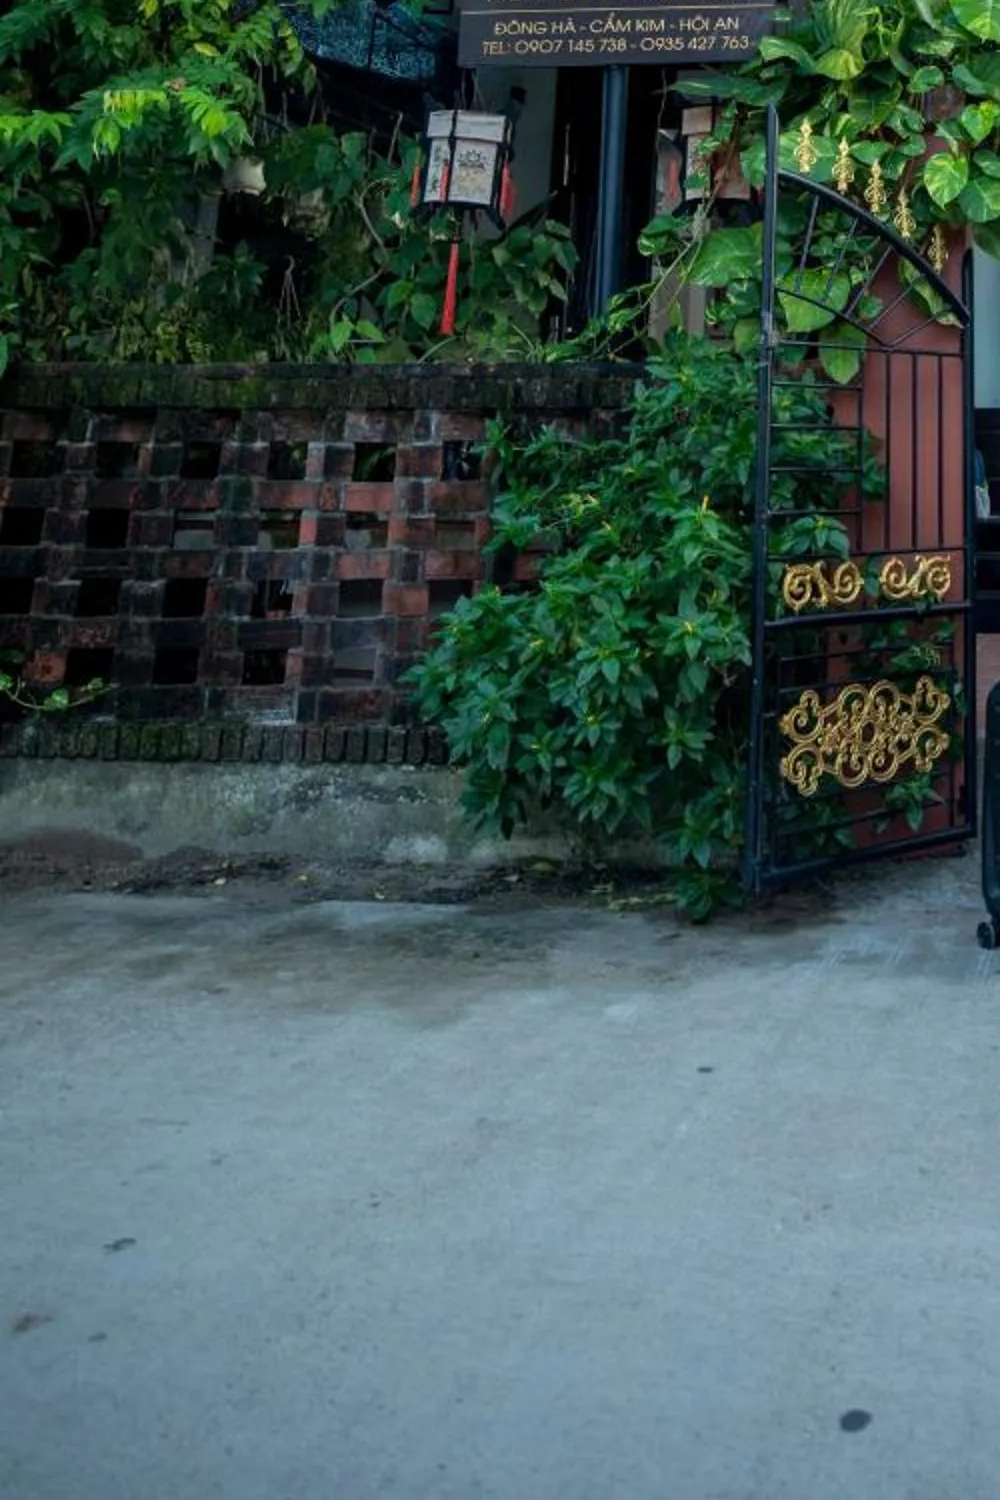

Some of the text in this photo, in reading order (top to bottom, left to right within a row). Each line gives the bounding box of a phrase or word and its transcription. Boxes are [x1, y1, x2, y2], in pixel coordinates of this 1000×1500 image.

[635, 18, 665, 32] KIM
[679, 15, 710, 35] HỘI
[712, 16, 740, 31] AN
[514, 38, 562, 54] 0907
[567, 38, 595, 53] 145
[599, 37, 627, 52] 738
[640, 36, 685, 52] 0935
[688, 35, 715, 51] 427
